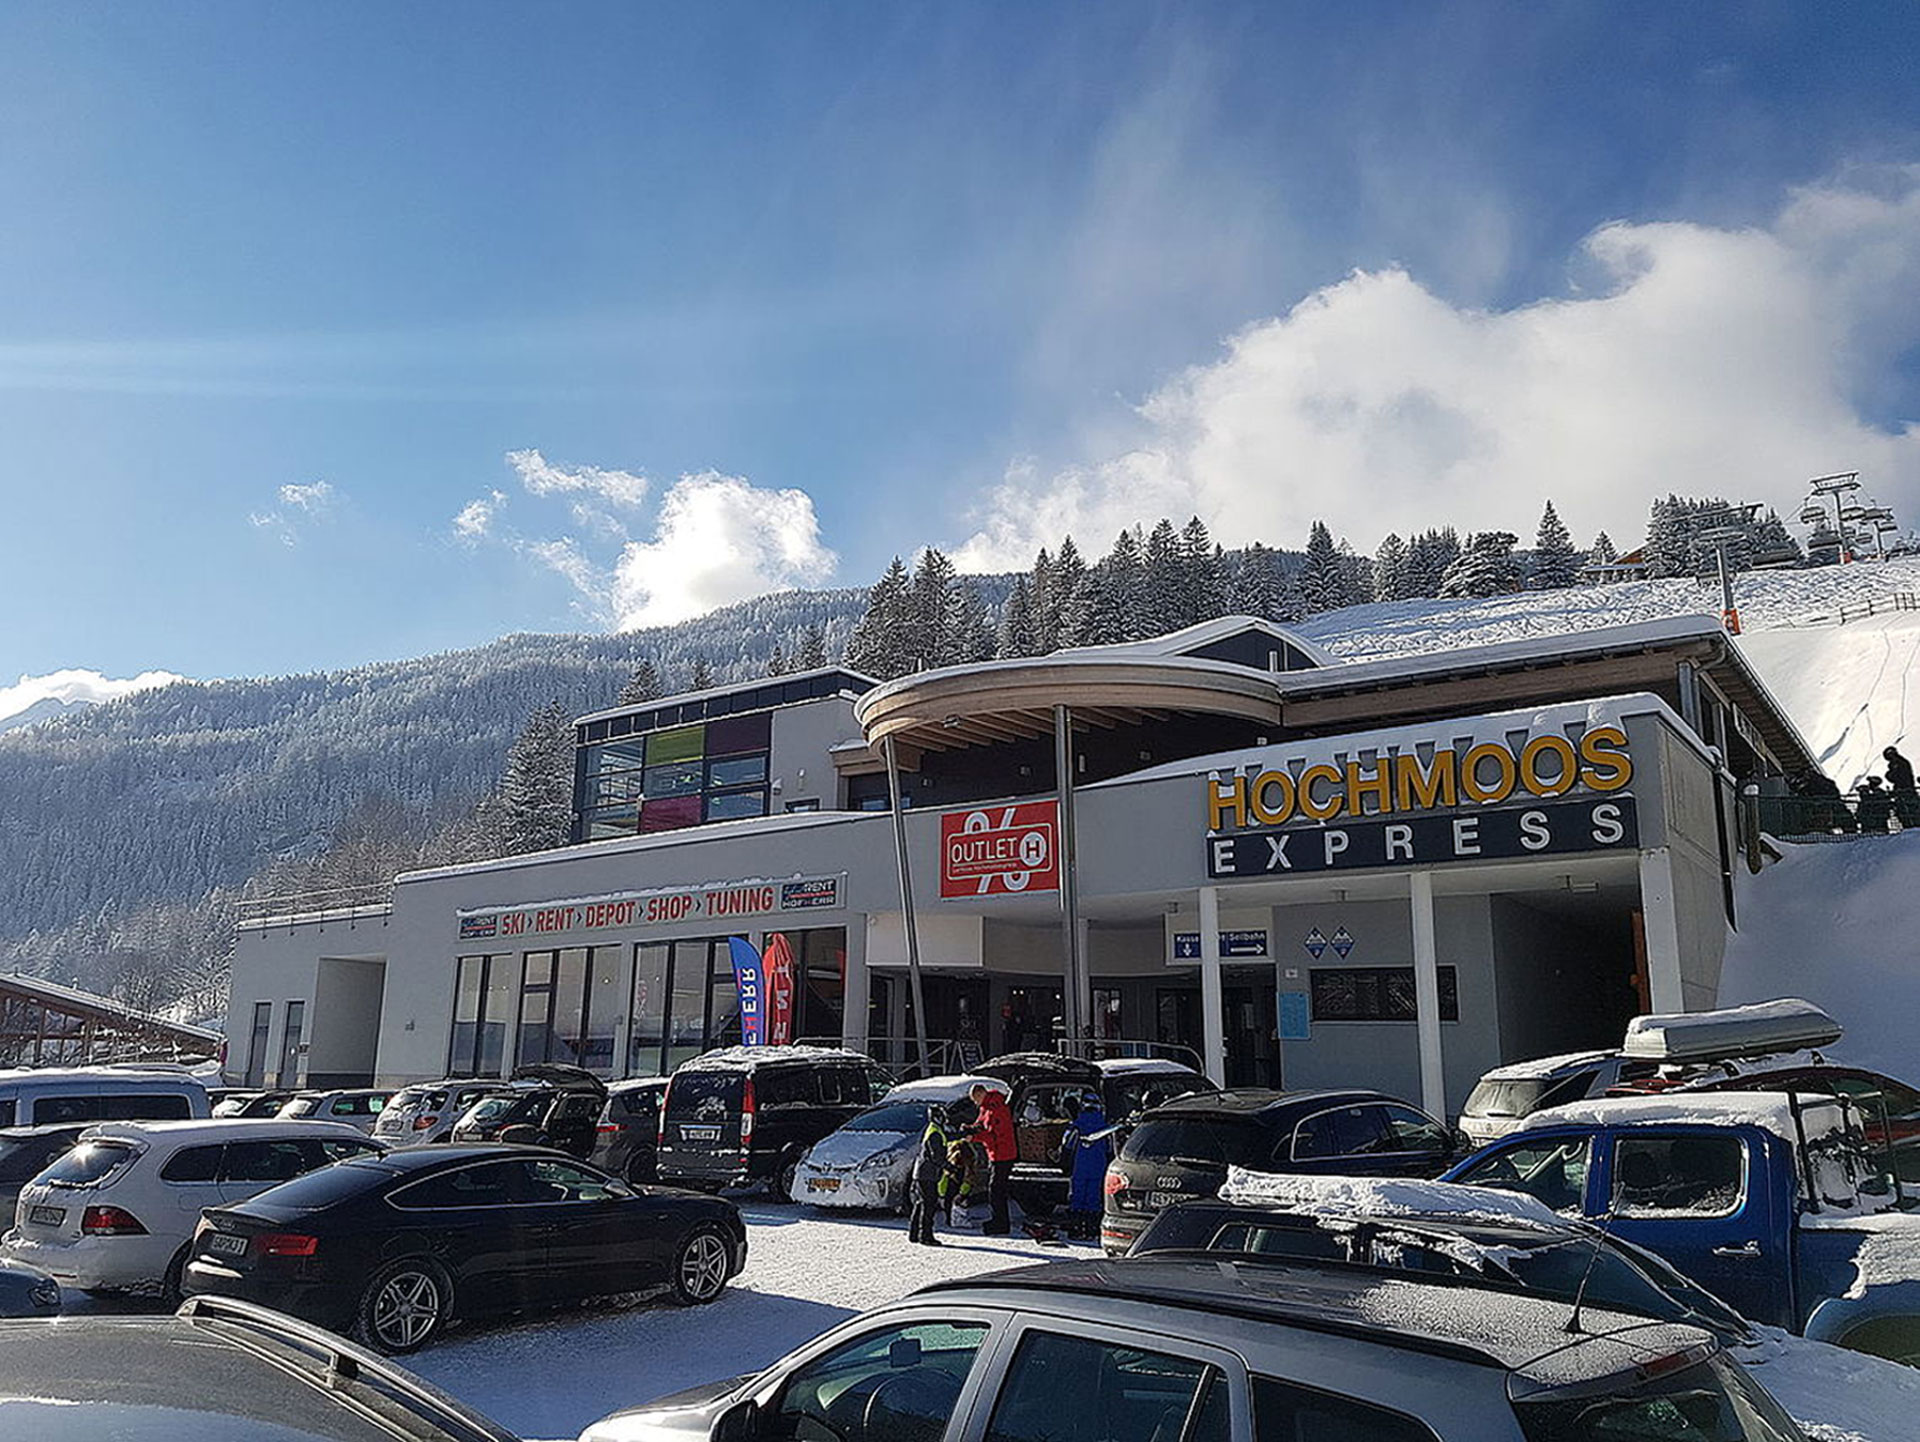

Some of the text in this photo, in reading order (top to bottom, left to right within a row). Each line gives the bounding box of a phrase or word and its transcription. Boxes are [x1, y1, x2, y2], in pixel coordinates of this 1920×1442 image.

[1208, 727, 1633, 831] HOCHMOOS
[951, 837, 1018, 863] OUTLET
[1213, 803, 1626, 874] EXPRESS
[501, 886, 773, 935] SKI RENT DEPOT SHOP TUNING
